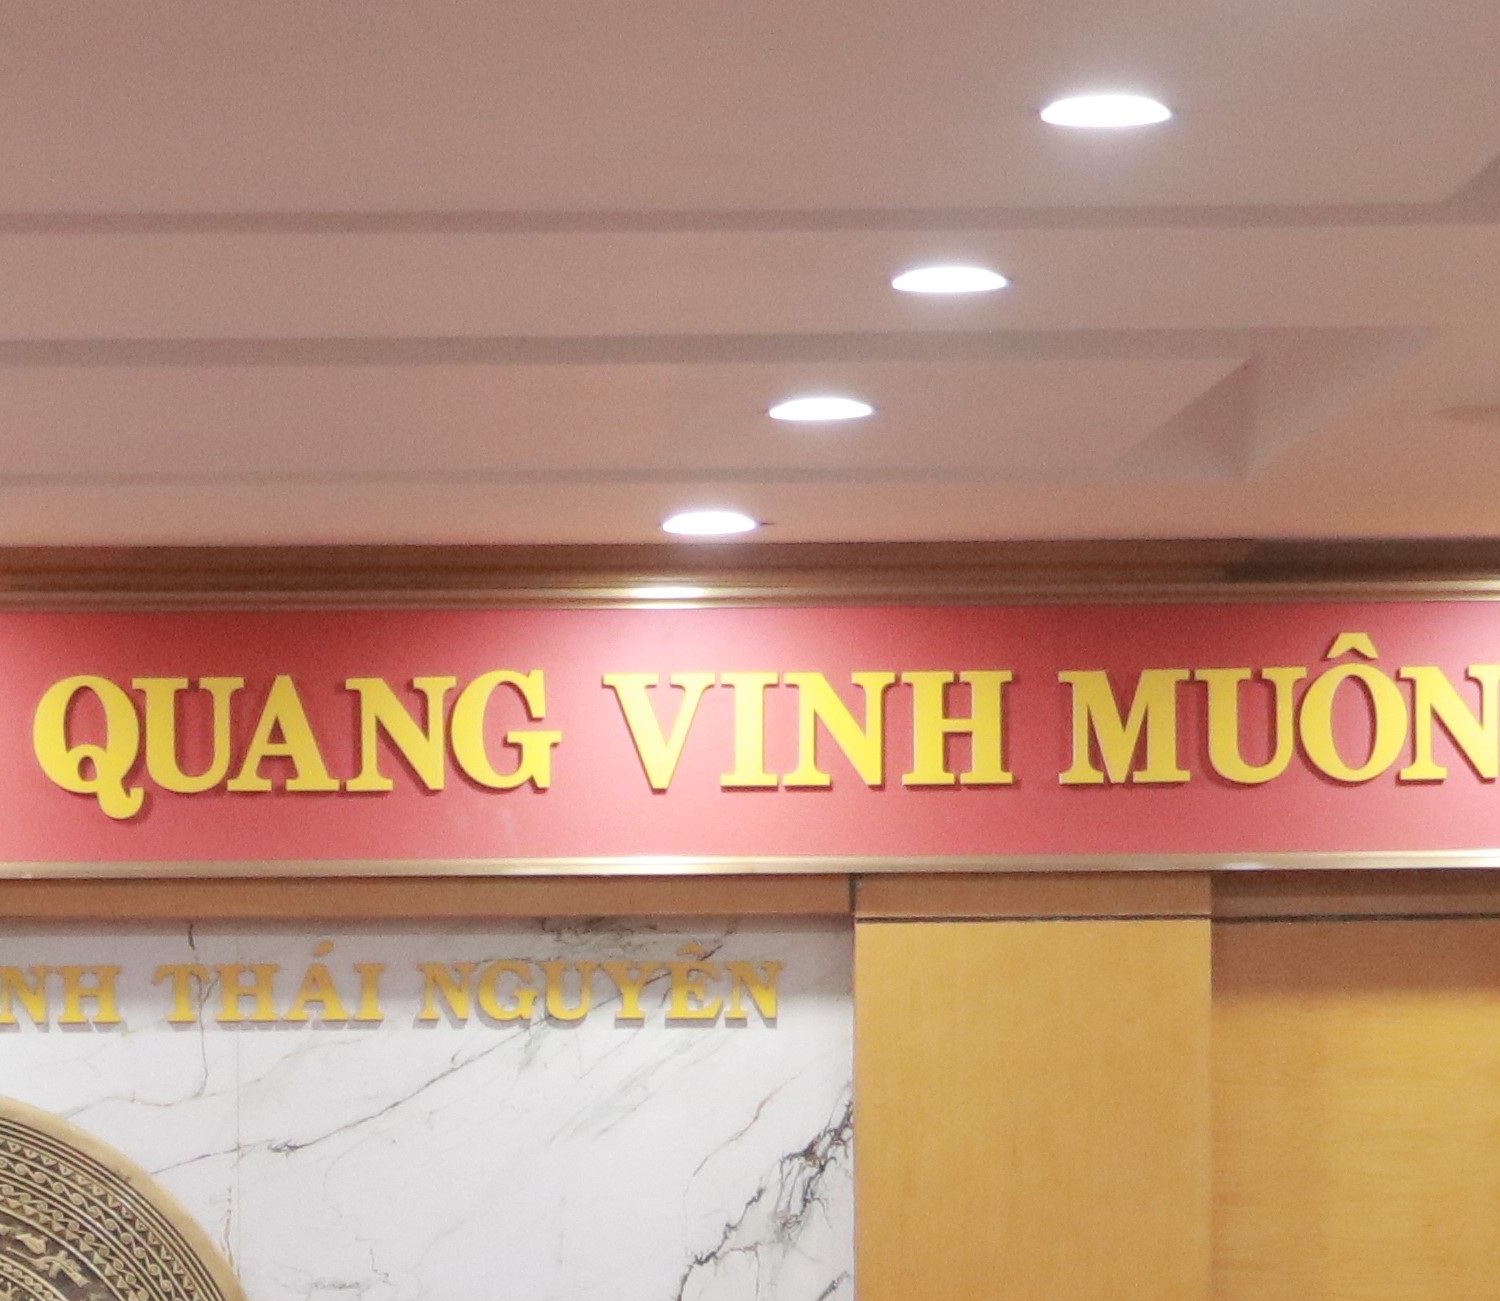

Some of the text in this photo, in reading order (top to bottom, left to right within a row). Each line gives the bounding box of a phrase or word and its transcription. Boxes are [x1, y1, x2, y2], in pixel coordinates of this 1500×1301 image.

[32, 668, 564, 818] QUANG
[603, 670, 1013, 788] VINH
[154, 940, 386, 1023] THÁI
[418, 943, 785, 1021] NGUYÊN
